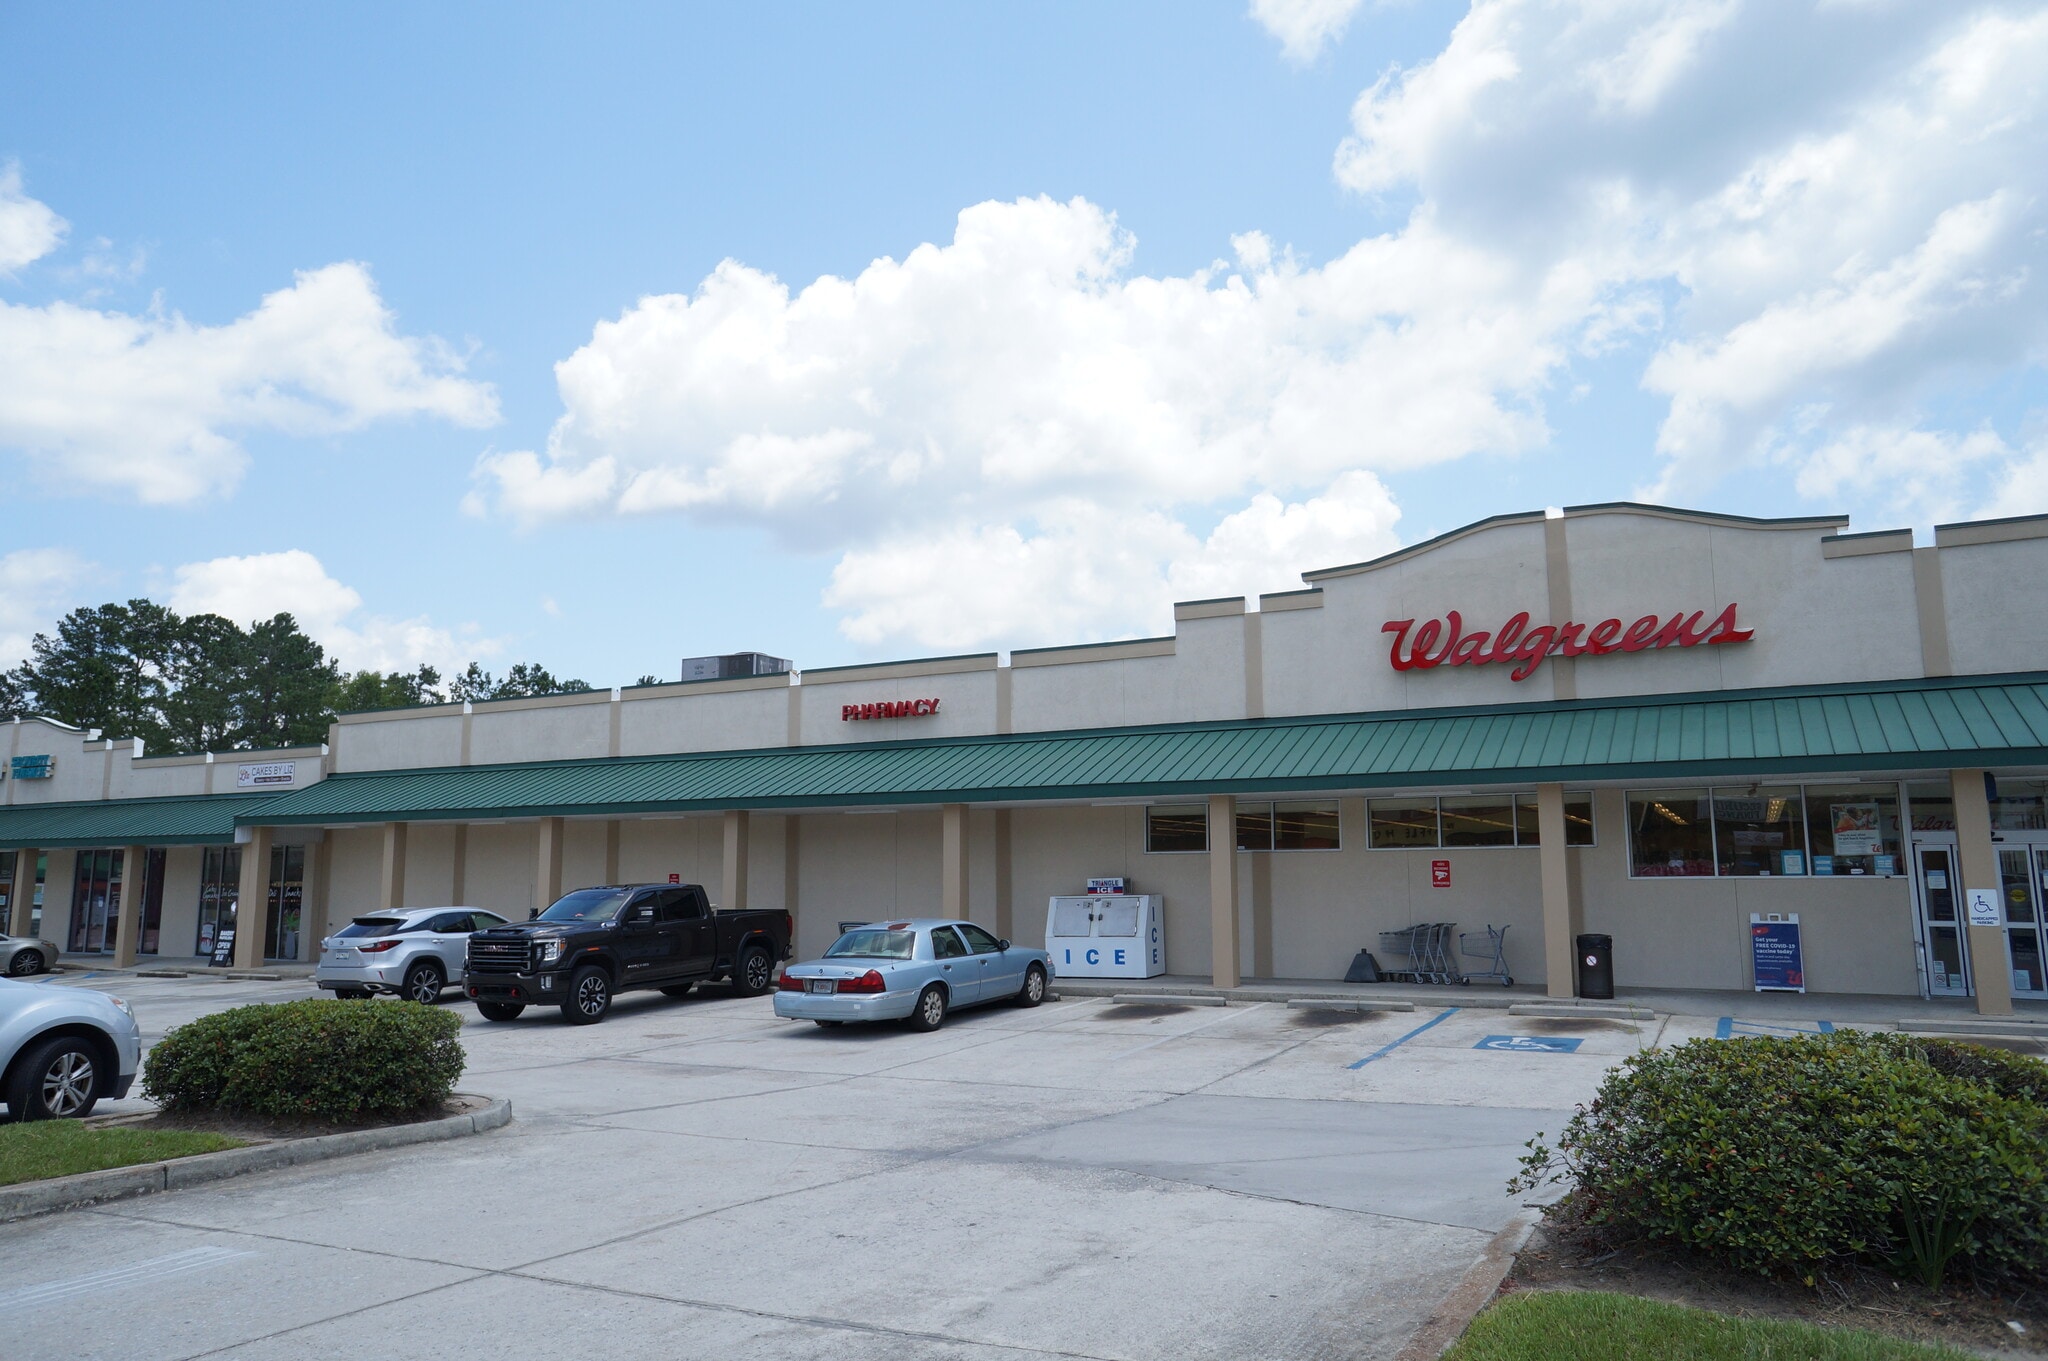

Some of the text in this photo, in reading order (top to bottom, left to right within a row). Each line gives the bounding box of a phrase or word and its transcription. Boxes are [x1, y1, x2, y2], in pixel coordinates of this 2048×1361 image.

[1381, 603, 1754, 682] Walgreens
[842, 698, 940, 721] PHARMACY
[252, 764, 294, 776] CAKES BY LIZ
[1065, 948, 1125, 965] ICE
